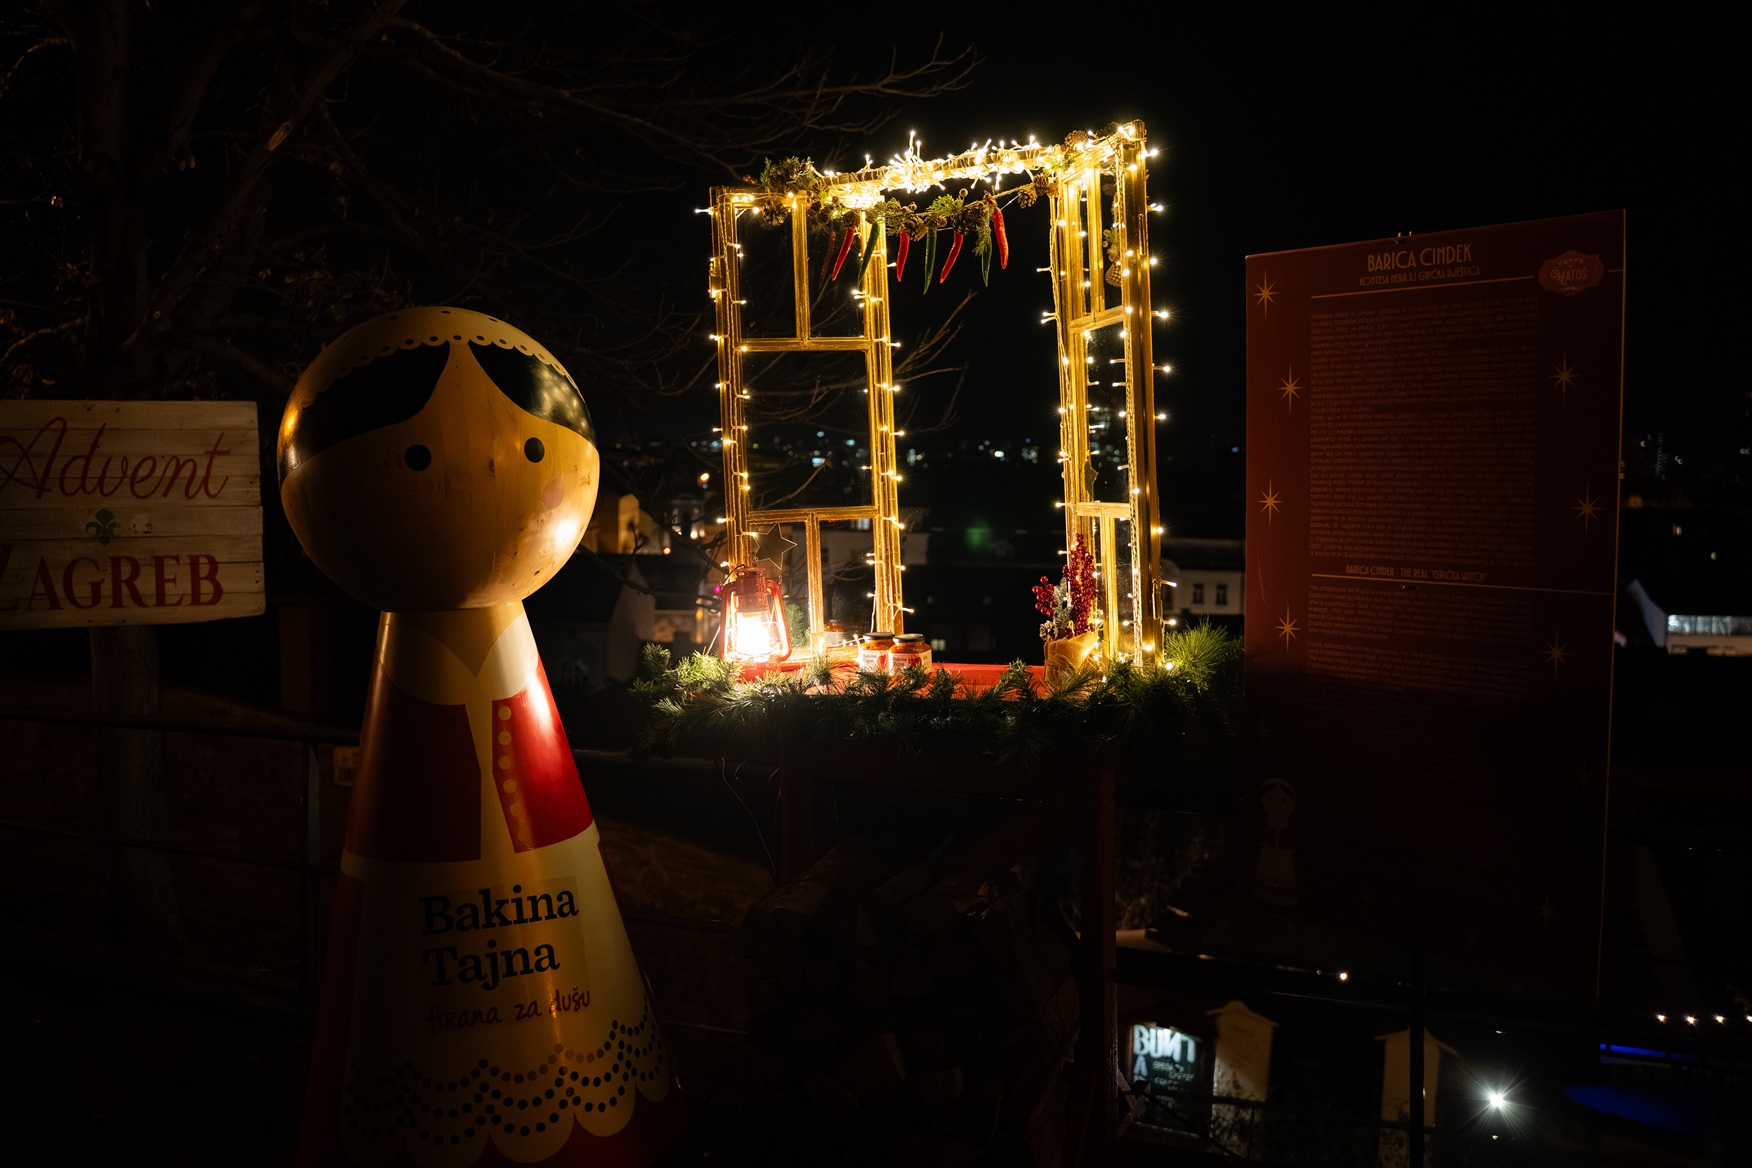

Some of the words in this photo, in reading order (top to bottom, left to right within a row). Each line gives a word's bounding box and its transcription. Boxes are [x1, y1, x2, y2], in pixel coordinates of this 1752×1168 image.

[1367, 250, 1416, 272] BARICA
[1419, 243, 1472, 266] CINDEK
[1359, 275, 1389, 287] KONTESA
[1390, 273, 1407, 284] NERA
[1408, 272, 1417, 282] ILI
[0, 417, 231, 499] Advent
[1345, 564, 1369, 575] BARICA
[1370, 565, 1395, 577] CINDEK
[1400, 567, 1412, 577] THE
[1413, 568, 1428, 579] REAL
[418, 884, 580, 937] Bakina
[422, 939, 561, 991] Tajna
[514, 1000, 542, 1020] za
[548, 987, 591, 1014] dušu
